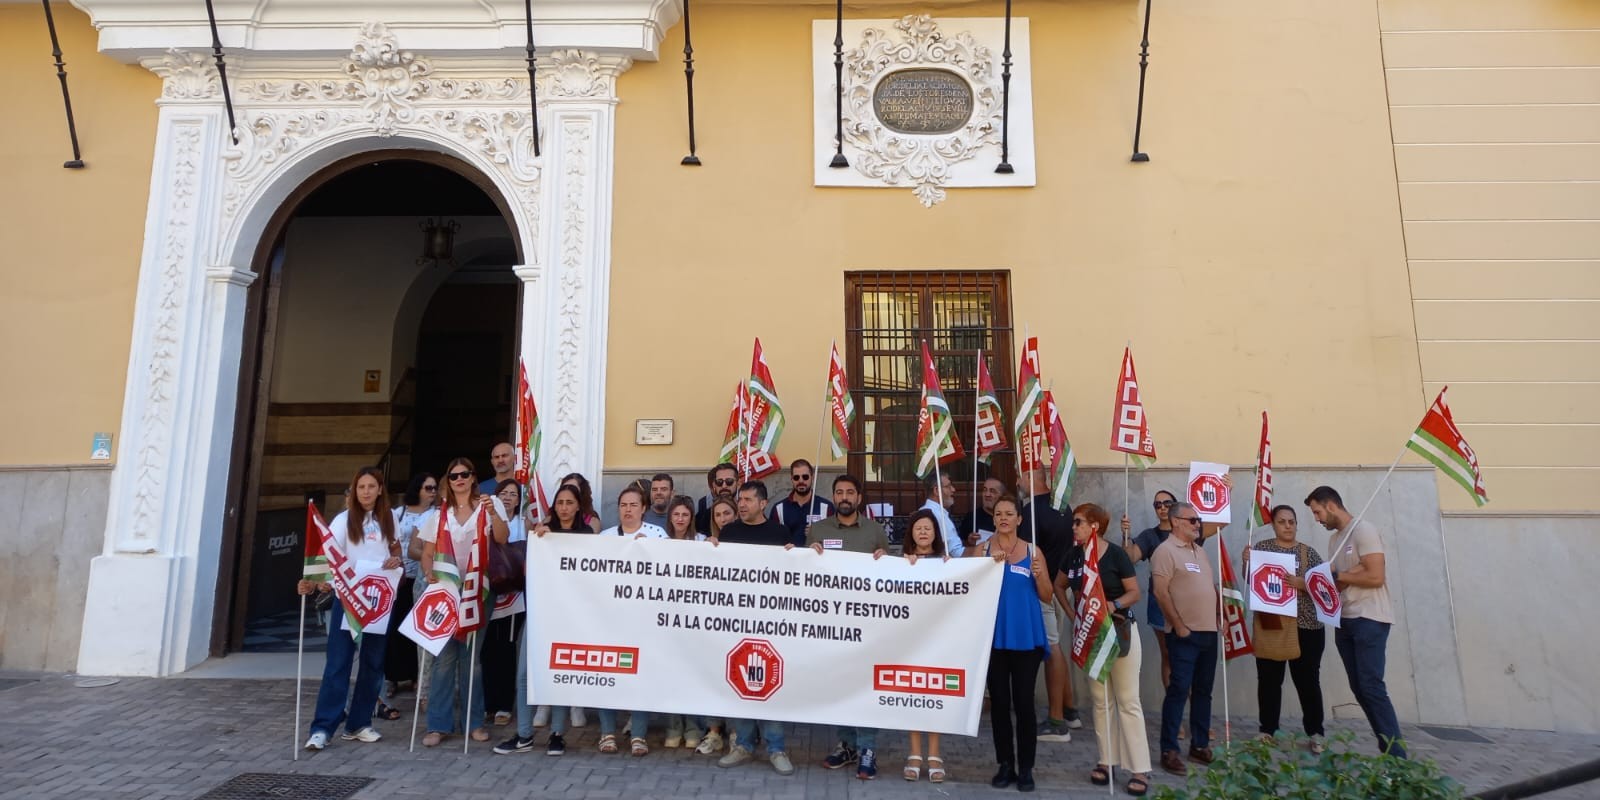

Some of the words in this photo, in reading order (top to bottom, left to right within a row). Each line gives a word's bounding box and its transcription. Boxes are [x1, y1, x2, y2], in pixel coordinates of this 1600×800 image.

[560, 556, 577, 571] EN
[580, 558, 632, 574] CONTRA
[636, 561, 652, 575] DE
[655, 562, 671, 577] LA
[674, 563, 780, 585] LIBERALIZACIÓN
[784, 571, 800, 586] DE
[804, 573, 871, 592] HORARIOS
[875, 579, 969, 595] COMERCIALES
[613, 585, 632, 599] NO
[636, 586, 645, 600] A
[649, 587, 664, 601] LA
[667, 588, 734, 607] APERTURA
[738, 594, 755, 608] EN
[760, 595, 829, 614] DOMINGOS
[833, 601, 842, 615] Y
[845, 602, 910, 620] FESTIVOS
[657, 612, 669, 627] SI
[672, 614, 681, 628] A
[685, 615, 700, 630] LA
[704, 617, 797, 637] CONCILIACIÓN
[801, 623, 862, 642] FAMILIAR
[555, 648, 617, 668] CCOO
[553, 672, 616, 687] servicios
[748, 665, 764, 682] NO
[878, 669, 943, 690] CCOO
[878, 695, 944, 710] servicios
